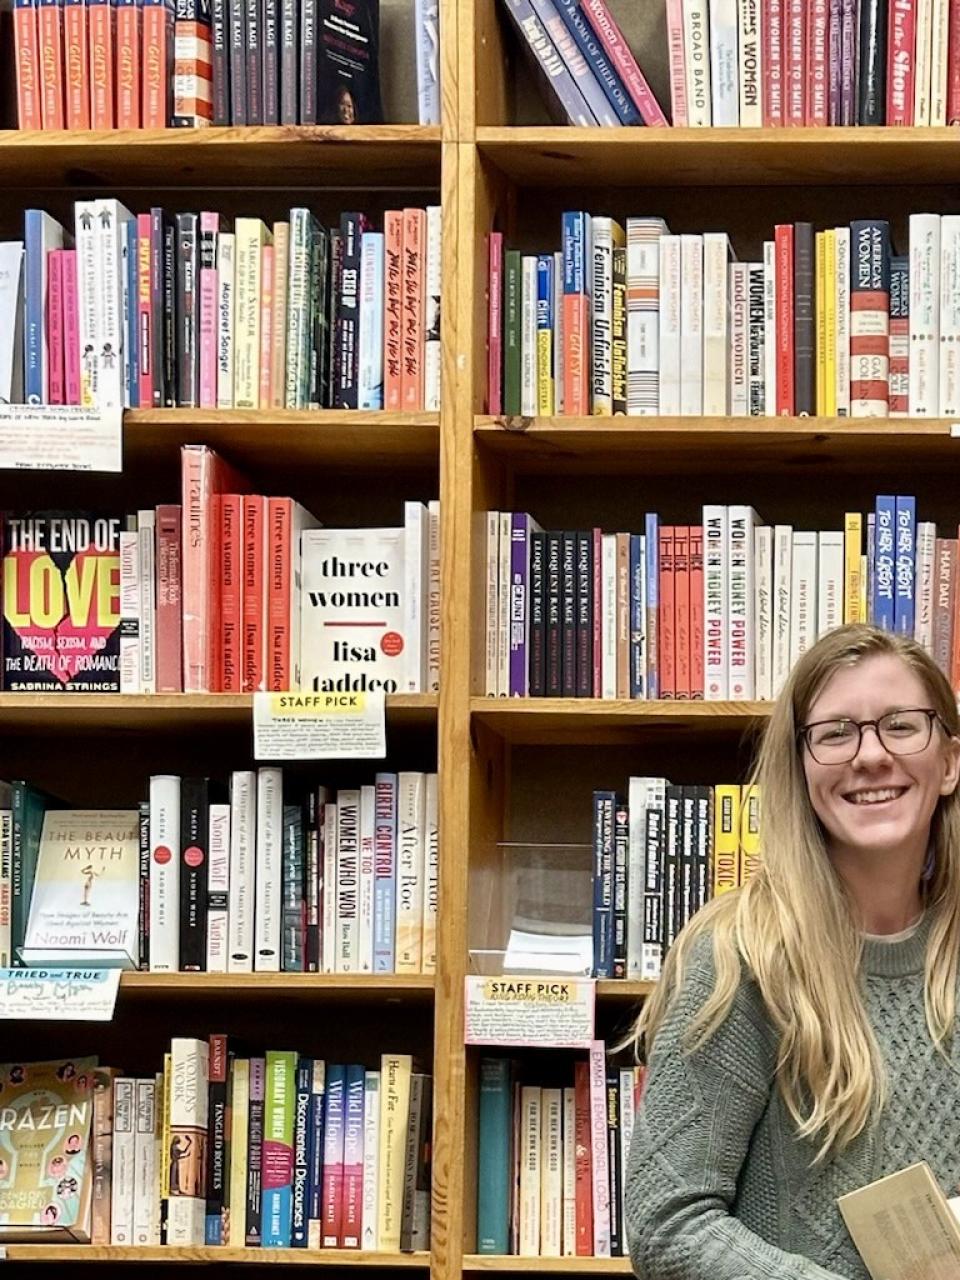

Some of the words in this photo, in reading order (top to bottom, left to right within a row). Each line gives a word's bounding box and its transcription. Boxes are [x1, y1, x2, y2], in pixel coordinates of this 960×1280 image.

[690, 12, 703, 62] BROAD
[771, 17, 781, 60] WOMEN
[694, 69, 706, 109] BAND
[744, 41, 758, 107] WOMAN
[771, 65, 780, 80] TO
[771, 84, 781, 118] SMILE
[859, 227, 871, 289] WOMEN
[872, 227, 882, 290] AMERICA'S
[594, 245, 611, 313] Feminism
[735, 270, 747, 327] modern
[750, 269, 765, 323] WOMEN
[222, 283, 232, 332] Margaret
[222, 336, 231, 373] Sanger
[594, 319, 611, 397] Unfinished
[735, 331, 747, 386] women
[9, 519, 46, 552] THE
[51, 519, 90, 552] END
[94, 519, 120, 552] OF
[275, 507, 286, 540] three
[708, 519, 722, 566] WOMEN
[274, 547, 285, 590] women
[321, 556, 389, 577] three
[939, 550, 950, 581] MARY
[4, 555, 121, 629] LOVE
[309, 591, 400, 607] women
[708, 570, 722, 614] MONEY
[799, 580, 807, 632] INVISIBLE
[939, 583, 950, 608] DALY
[333, 641, 377, 662] lisa
[708, 620, 722, 666] POWER
[11, 682, 63, 691] SABRINA
[66, 683, 118, 691] STRINGS
[280, 696, 321, 707] STAFF
[325, 696, 358, 706] PICK
[312, 673, 398, 693] taddeo
[375, 783, 393, 819] BIRTH
[339, 806, 357, 852] WOMEN
[401, 821, 417, 868] After
[64, 847, 124, 861] MYTH
[340, 857, 357, 886] WHO
[375, 825, 393, 880] CONTROL
[718, 851, 735, 887] TOXIC
[340, 890, 356, 918] WON
[401, 875, 417, 910] Roe
[35, 932, 86, 945] Naomi
[92, 930, 129, 945] Wolf
[7, 970, 48, 979] TRIED
[66, 971, 102, 980] TRUE
[492, 983, 533, 994] STAFF
[537, 983, 568, 995] PICK
[174, 1062, 185, 1102] WORK
[185, 1052, 198, 1113] WOMEN'S
[328, 1080, 343, 1112] Wild
[296, 1093, 309, 1165] Discontented
[327, 1117, 342, 1154] Hope
[294, 1168, 307, 1228] Discourses
